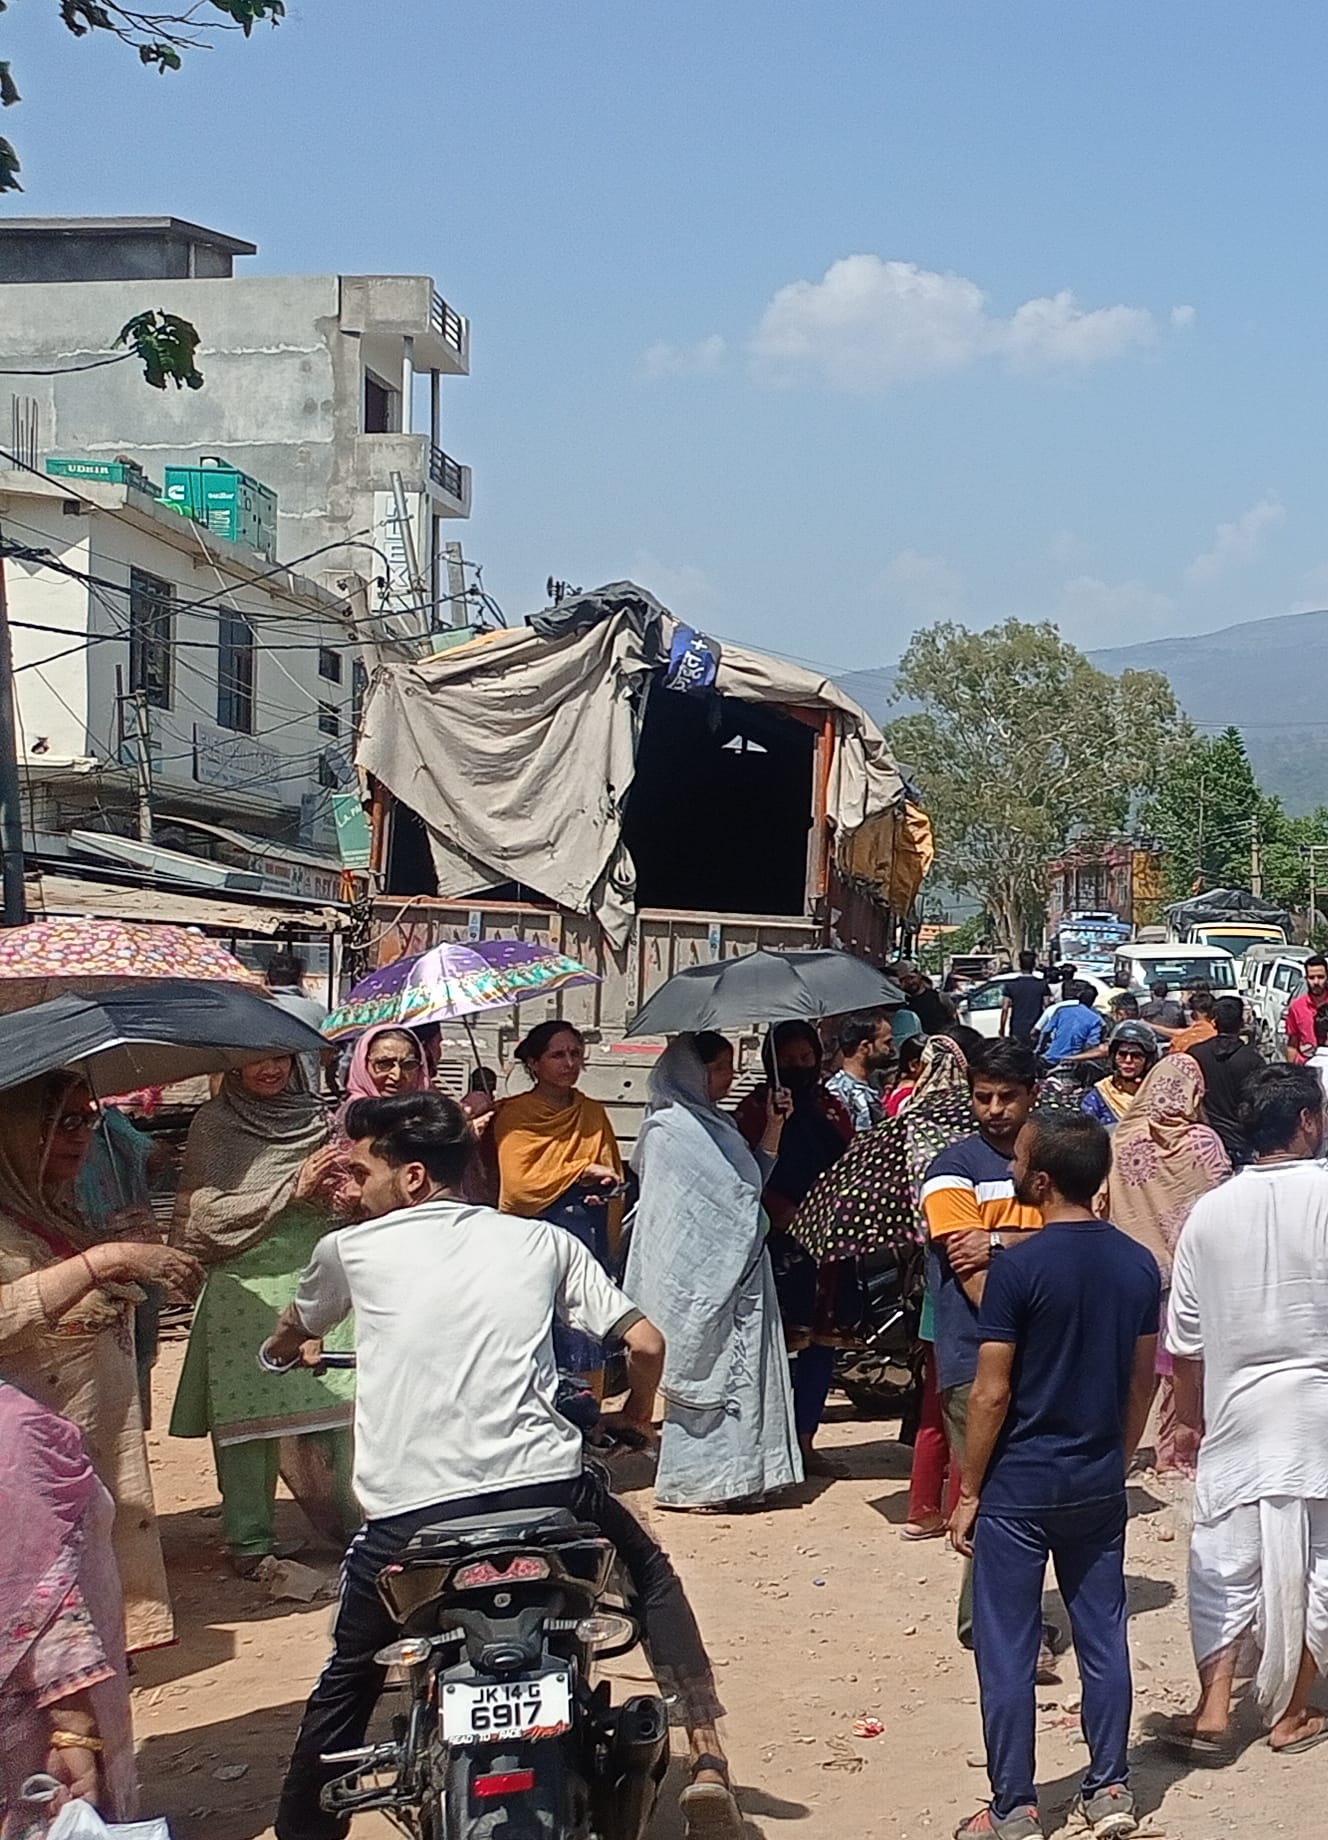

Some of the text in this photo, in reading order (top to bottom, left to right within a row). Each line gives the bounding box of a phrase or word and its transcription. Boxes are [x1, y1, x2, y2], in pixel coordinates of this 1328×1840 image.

[472, 1687, 498, 1704] JK
[505, 1685, 523, 1701] 14
[471, 1700, 542, 1730] 6917
